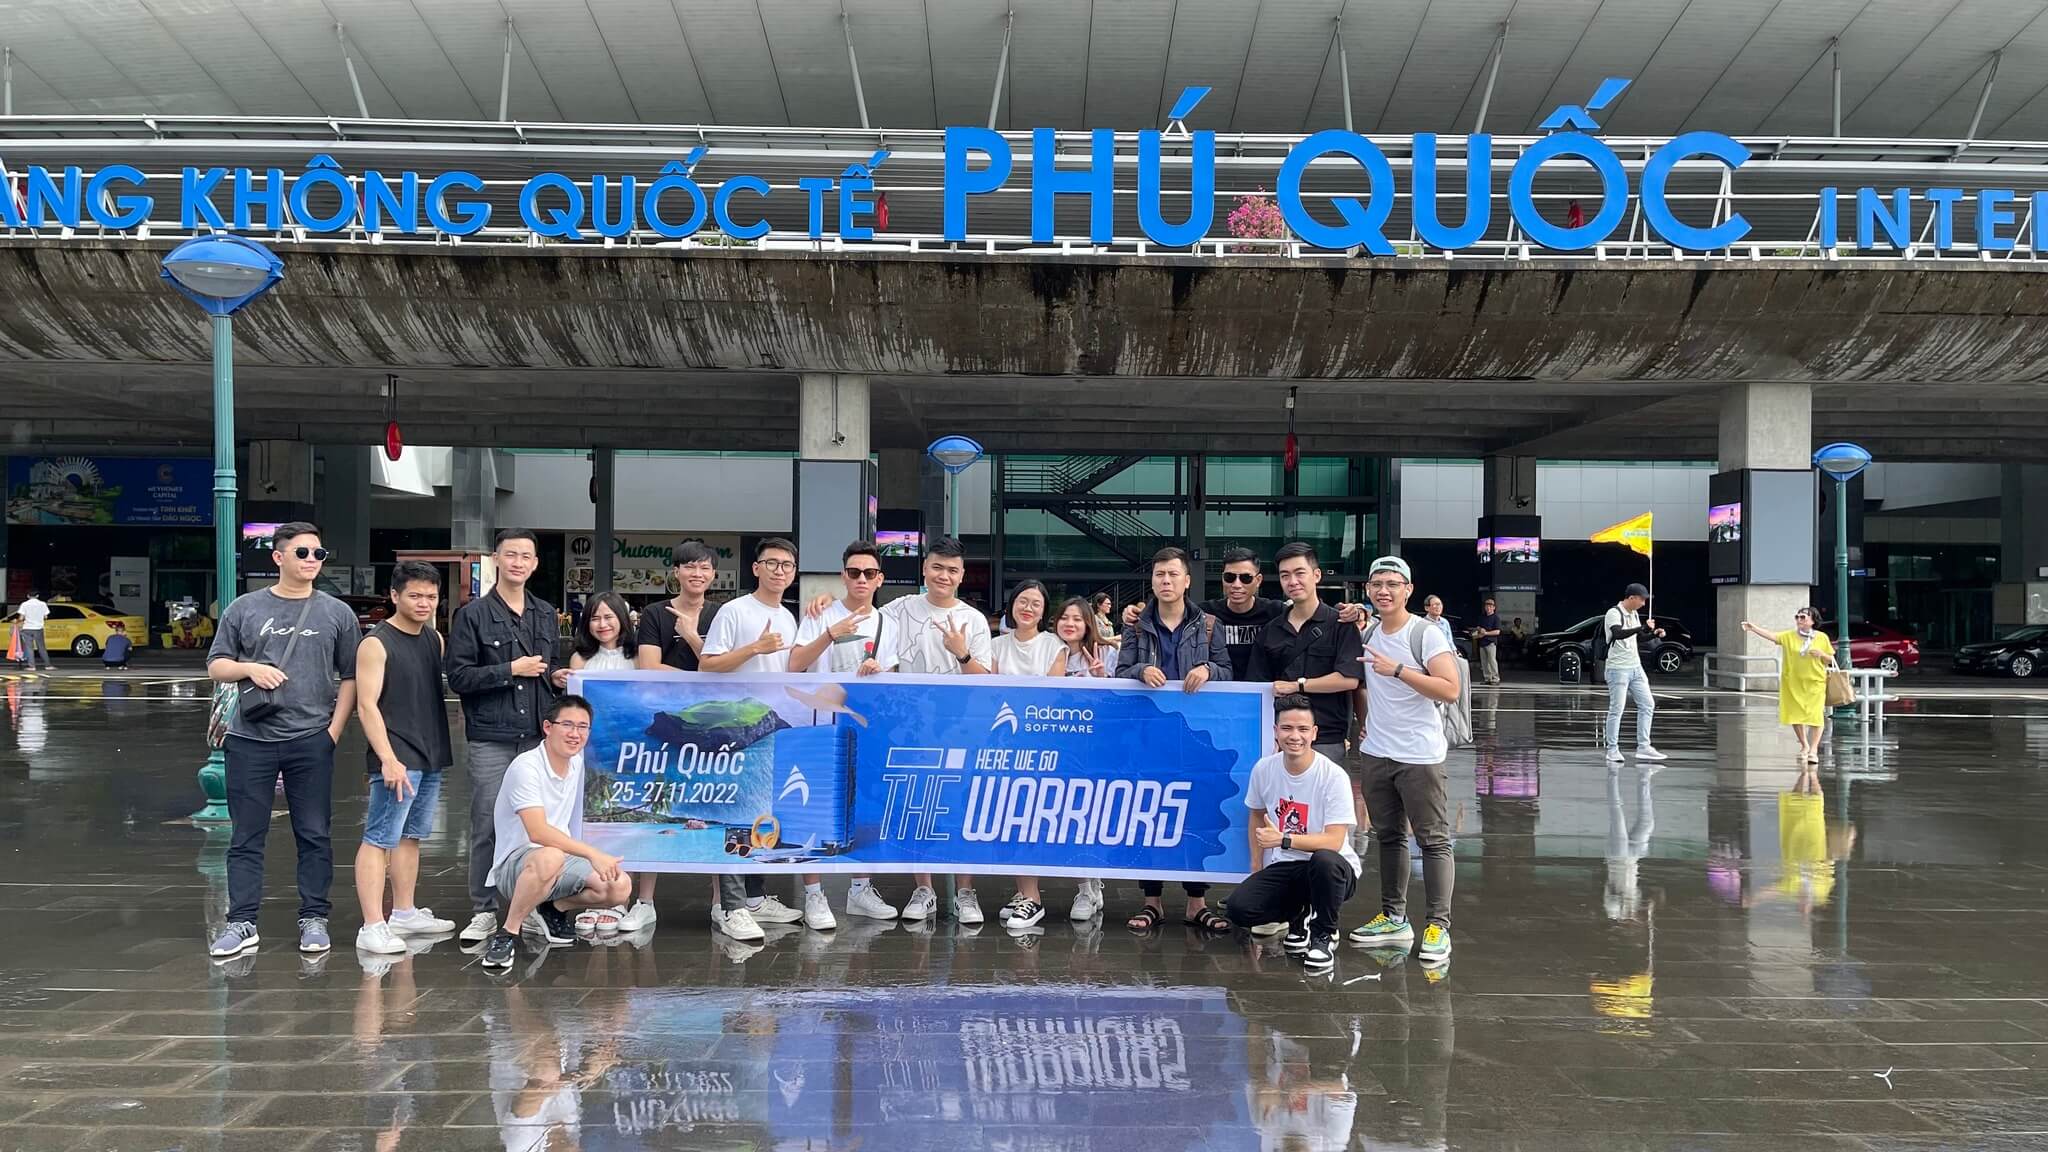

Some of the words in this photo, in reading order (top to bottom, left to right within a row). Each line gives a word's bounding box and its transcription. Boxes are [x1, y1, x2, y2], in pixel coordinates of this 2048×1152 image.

[181, 155, 491, 235] KHÔNG
[519, 147, 772, 240] QUỐC
[799, 150, 891, 240] TẾ
[943, 87, 1215, 247] PHÚ
[1277, 79, 1753, 256] QUỐC
[1820, 187, 2048, 252] INTE
[1025, 704, 1094, 721] Adamo
[1024, 723, 1094, 734] SOFTWARE
[616, 742, 669, 774] Phú
[677, 741, 746, 779] Quốc
[975, 748, 1013, 770] HERE
[1014, 749, 1038, 771] WE
[1038, 750, 1059, 772] GO
[610, 781, 739, 804] 25-27.11.2022
[879, 774, 962, 841] THE
[961, 775, 1193, 848] WARRIORS
